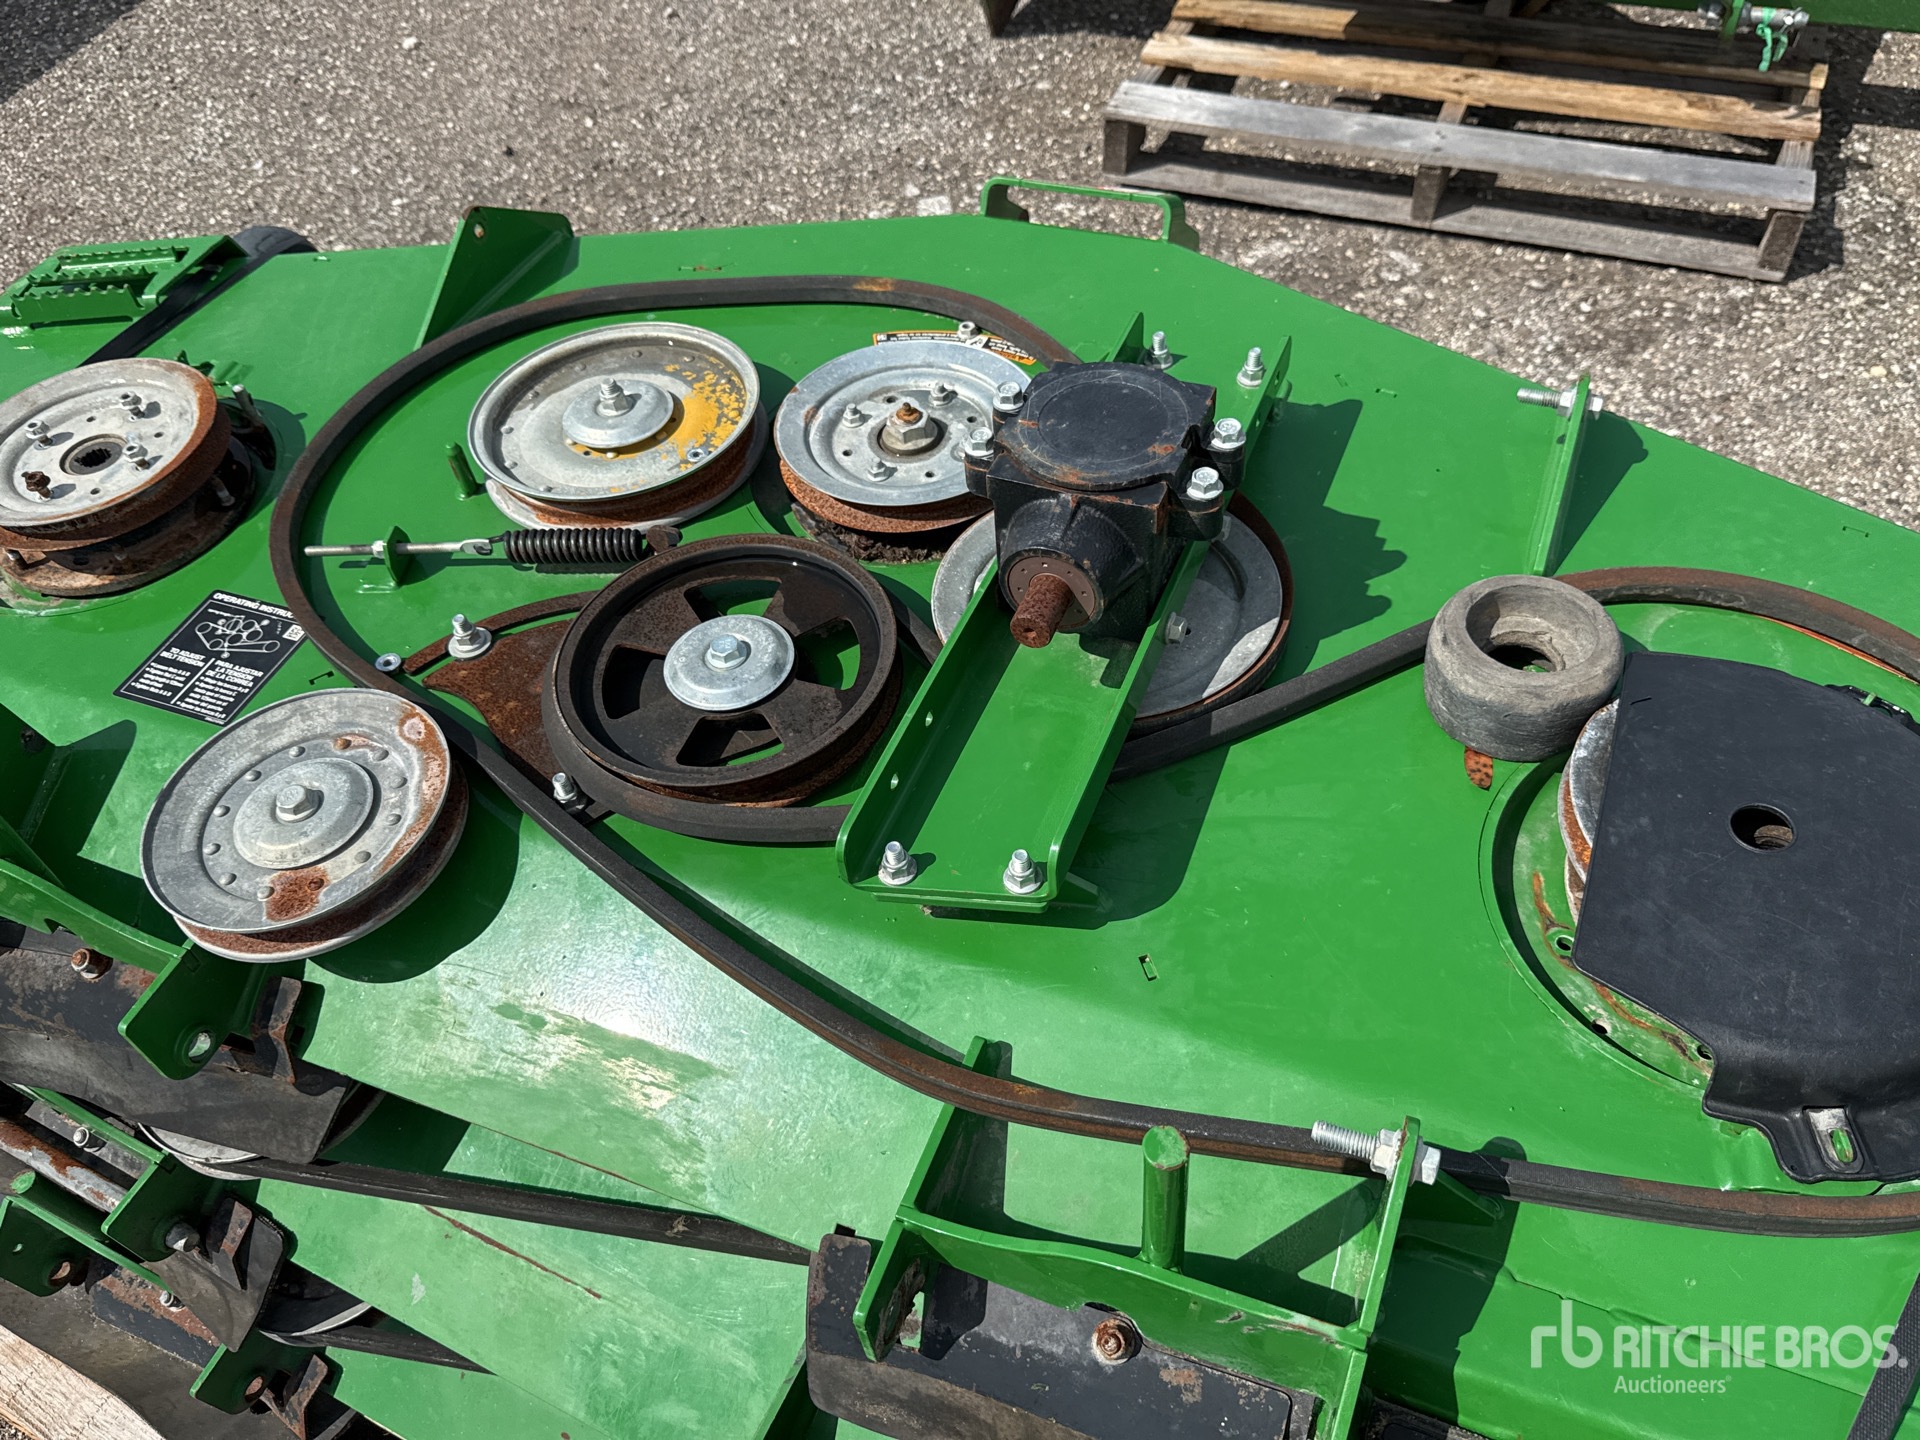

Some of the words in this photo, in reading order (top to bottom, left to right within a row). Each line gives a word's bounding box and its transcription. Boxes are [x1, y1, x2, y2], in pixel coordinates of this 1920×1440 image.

[213, 592, 260, 609] OPERATING
[176, 656, 206, 668] TENSION
[179, 649, 206, 661] ADJUST
[214, 659, 234, 669] PARA
[232, 664, 264, 678] AJUSTAR
[205, 669, 217, 677] DE
[216, 672, 227, 680] LA
[226, 675, 254, 688] CORREA
